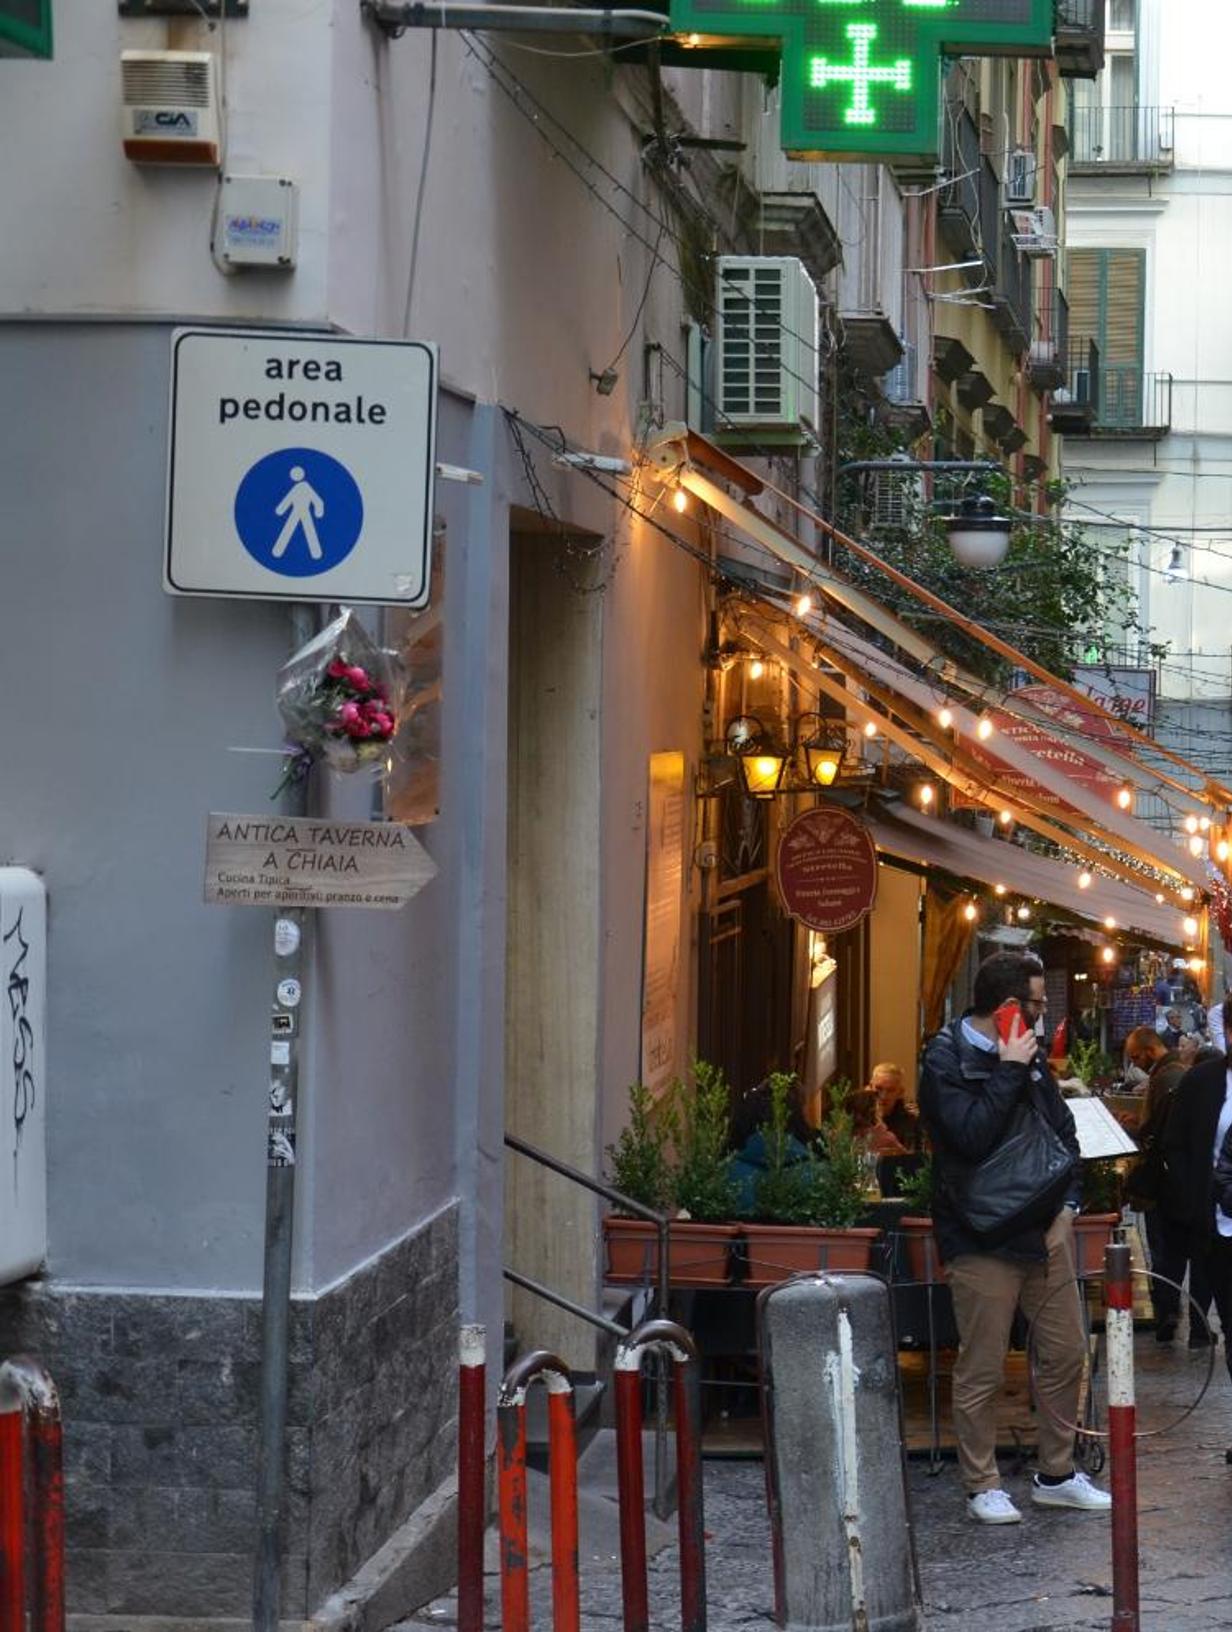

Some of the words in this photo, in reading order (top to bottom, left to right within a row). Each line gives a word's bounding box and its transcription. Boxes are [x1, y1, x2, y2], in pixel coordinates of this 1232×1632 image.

[265, 357, 343, 382] area
[219, 392, 387, 425] pedonale
[216, 822, 299, 844] ANTICA
[308, 827, 406, 849] TAVERNA
[262, 852, 279, 870] A
[286, 851, 360, 873] CHIAIA
[217, 872, 256, 885] Cucina
